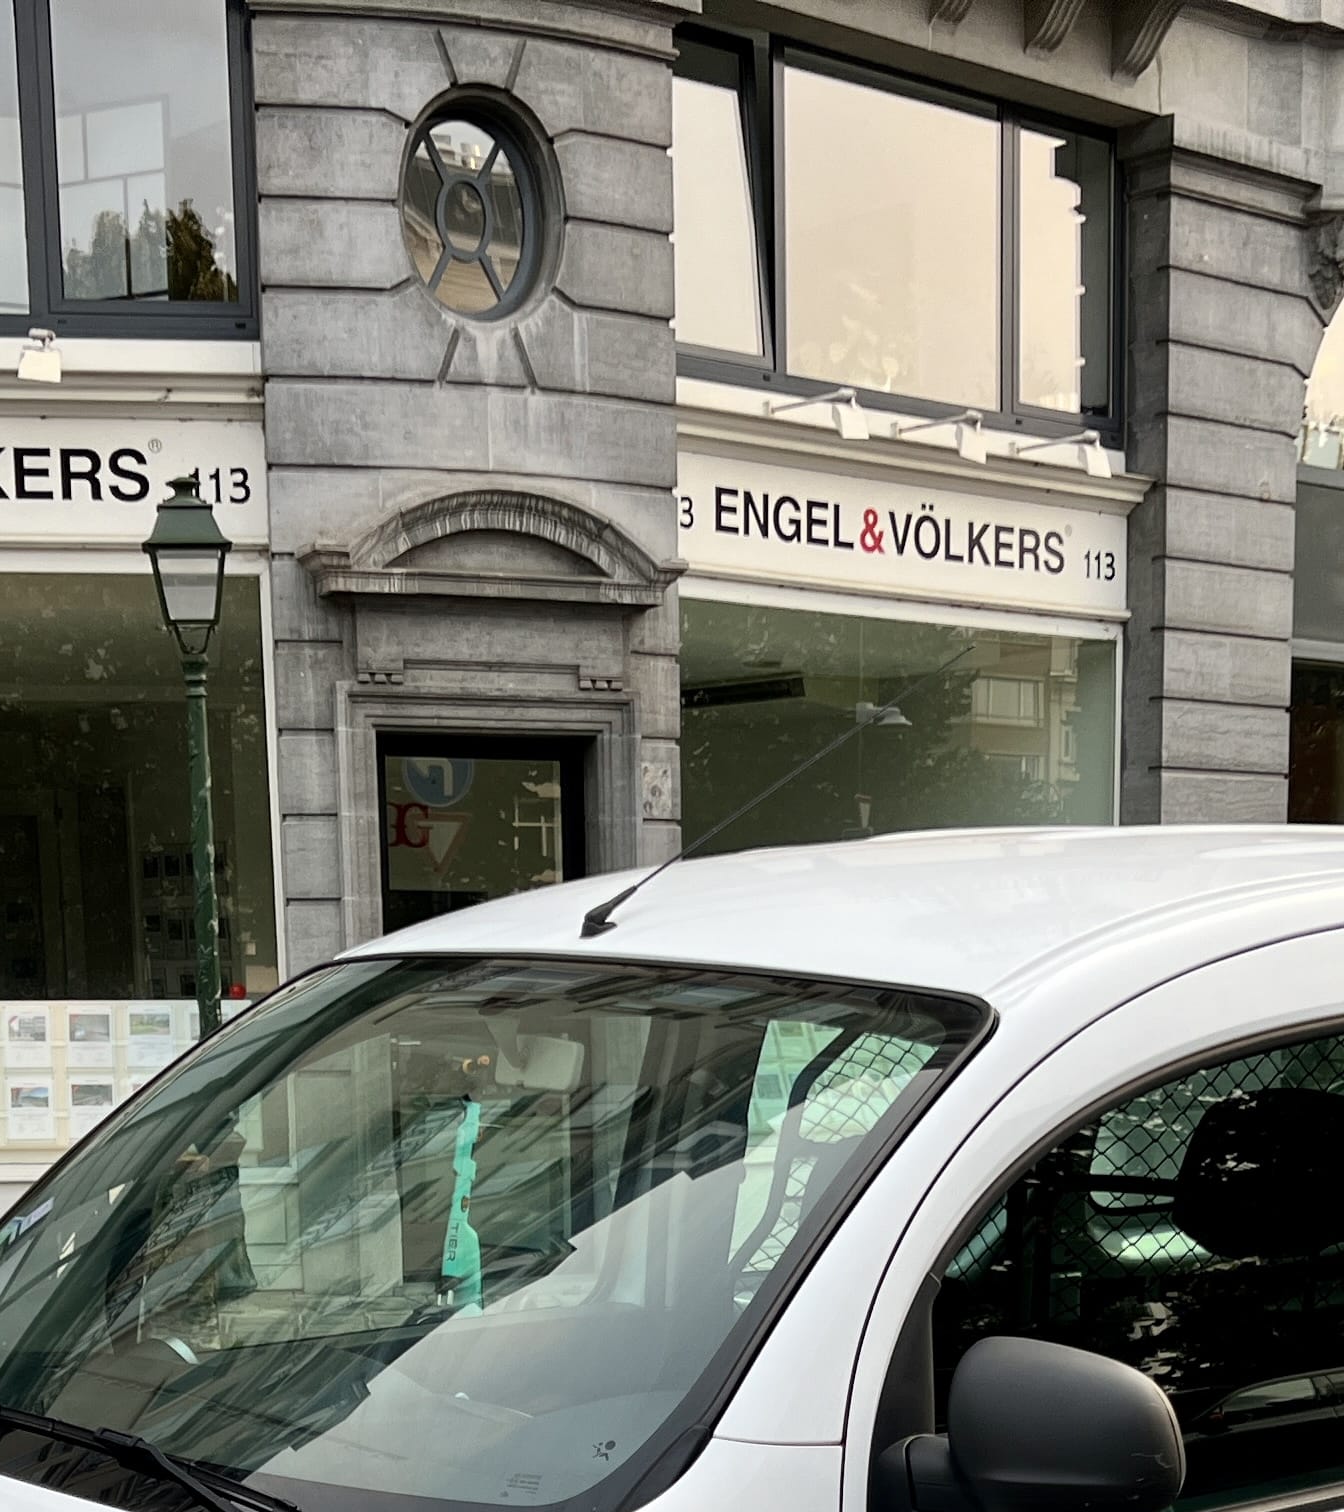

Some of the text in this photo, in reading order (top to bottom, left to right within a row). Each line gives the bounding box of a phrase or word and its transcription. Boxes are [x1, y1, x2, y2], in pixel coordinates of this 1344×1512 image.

[187, 467, 251, 504] 113
[1083, 549, 1118, 582] 113
[447, 1222, 459, 1261] TIER
